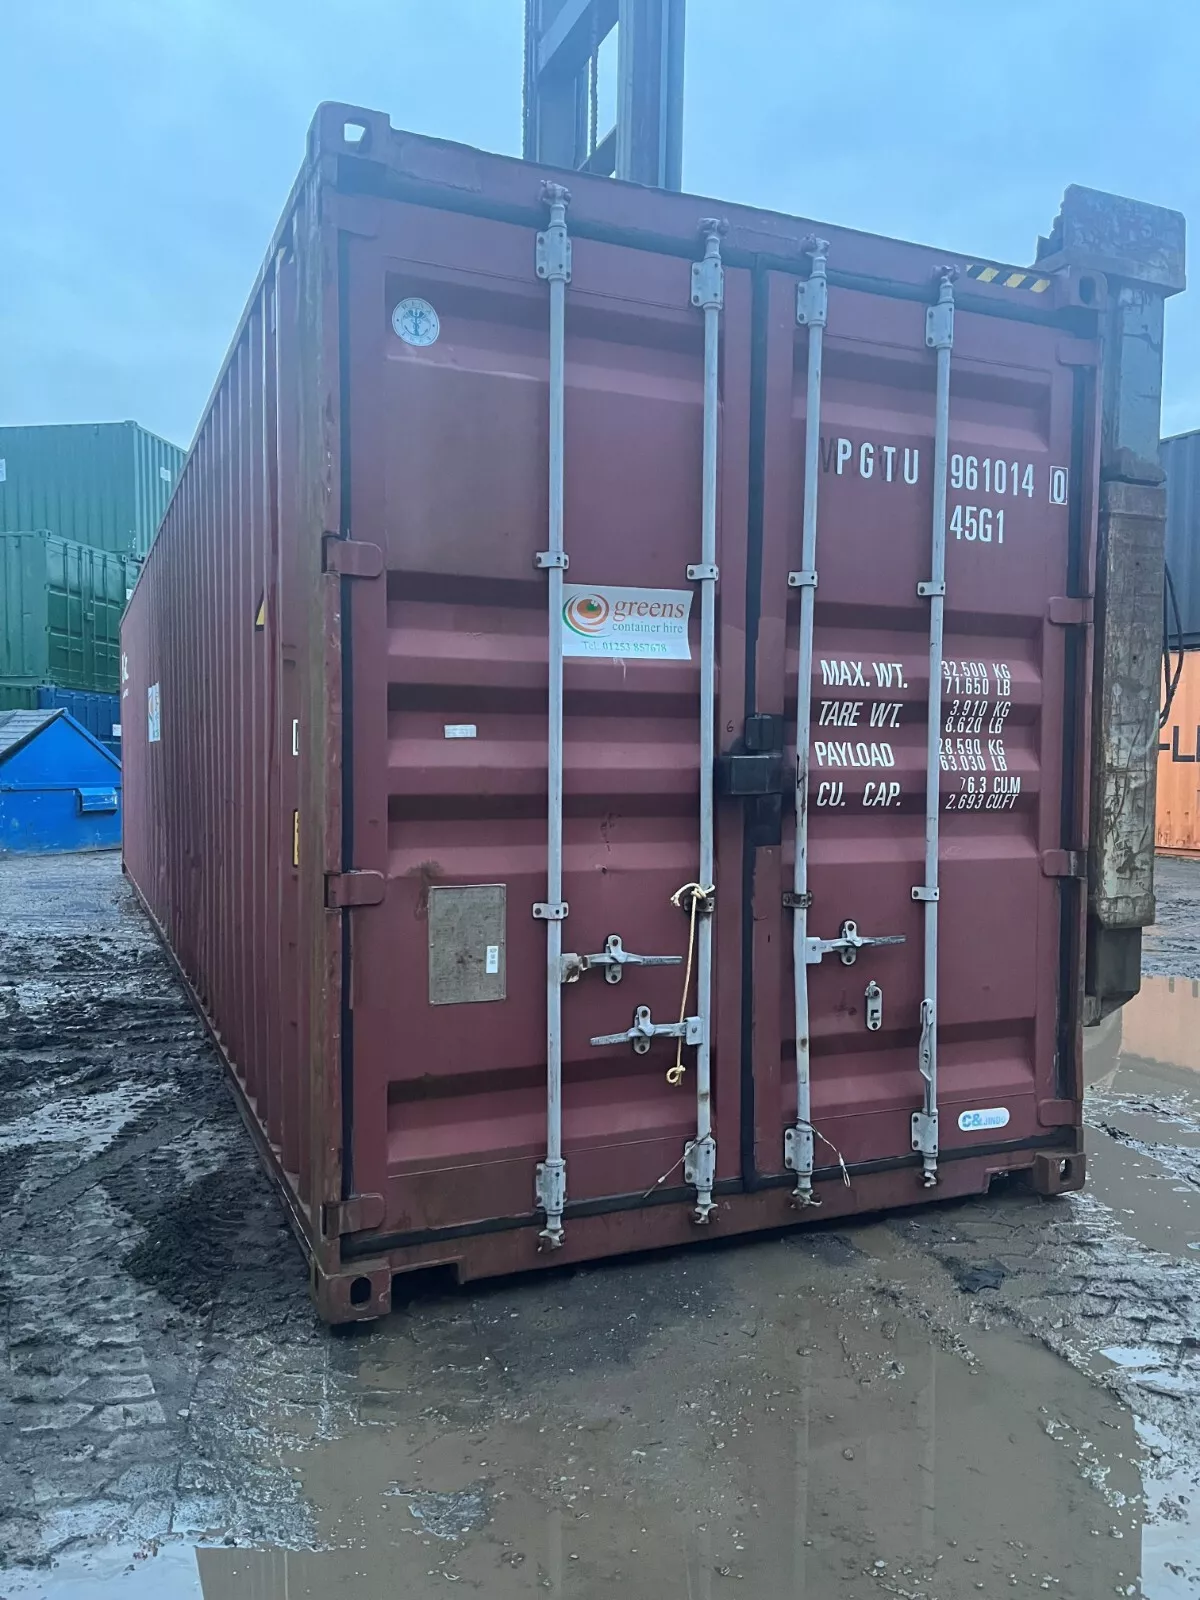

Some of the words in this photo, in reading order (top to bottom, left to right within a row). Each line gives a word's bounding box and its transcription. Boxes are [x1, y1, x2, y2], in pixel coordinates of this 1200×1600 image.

[837, 438, 919, 484] PGTU
[951, 454, 1034, 498] 961014
[1053, 469, 1066, 503] 0
[950, 505, 1004, 543] 45G1
[613, 600, 685, 622] greens
[612, 621, 661, 633] container
[663, 622, 683, 634] hire
[602, 641, 631, 652] 01253
[820, 660, 871, 687] MAX.
[872, 662, 908, 689] WT.
[941, 660, 987, 677] 32.500
[992, 663, 1011, 679] KG
[945, 676, 989, 695] 71.650
[996, 679, 1011, 696] LB
[818, 701, 864, 727] TARE
[869, 702, 904, 728] WT.
[949, 699, 988, 716] 3.910
[992, 701, 1011, 717] KG
[945, 716, 983, 733] 8.620
[988, 717, 1004, 734] LB
[814, 741, 895, 768] PAYLOAD
[988, 739, 1005, 756] KG
[940, 755, 987, 771] 63.030
[991, 755, 1008, 772] LB
[816, 782, 847, 807] CU.
[862, 782, 902, 807] CAP.
[959, 776, 987, 794] 76.3
[993, 776, 1021, 794] CU.M
[945, 793, 984, 809] 2.693
[985, 793, 1019, 810] CU.FT
